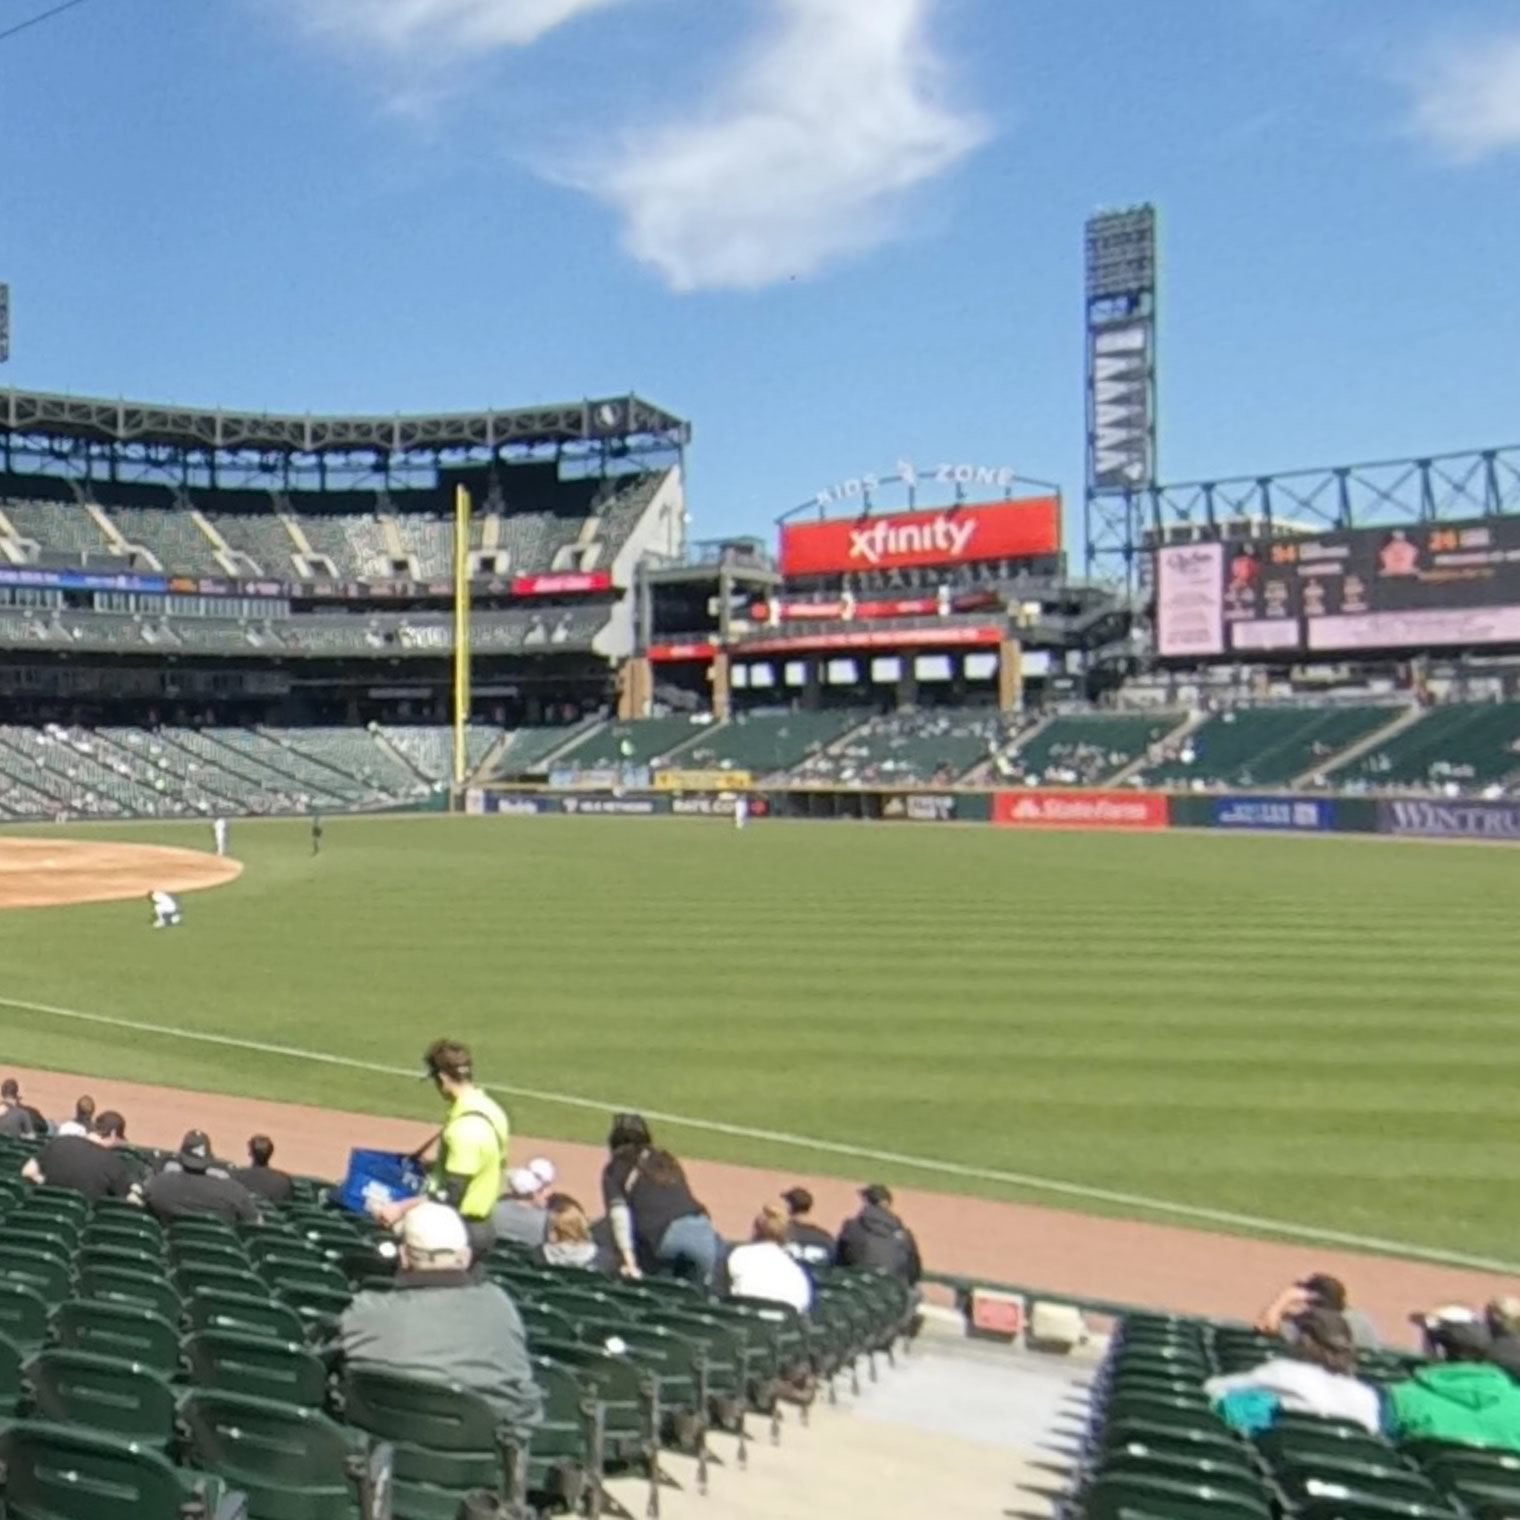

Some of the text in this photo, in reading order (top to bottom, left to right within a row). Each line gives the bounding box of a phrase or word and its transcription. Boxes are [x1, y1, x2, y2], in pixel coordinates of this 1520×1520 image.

[816, 463, 1016, 506] KIDS ZONE
[848, 515, 978, 564] xfinity
